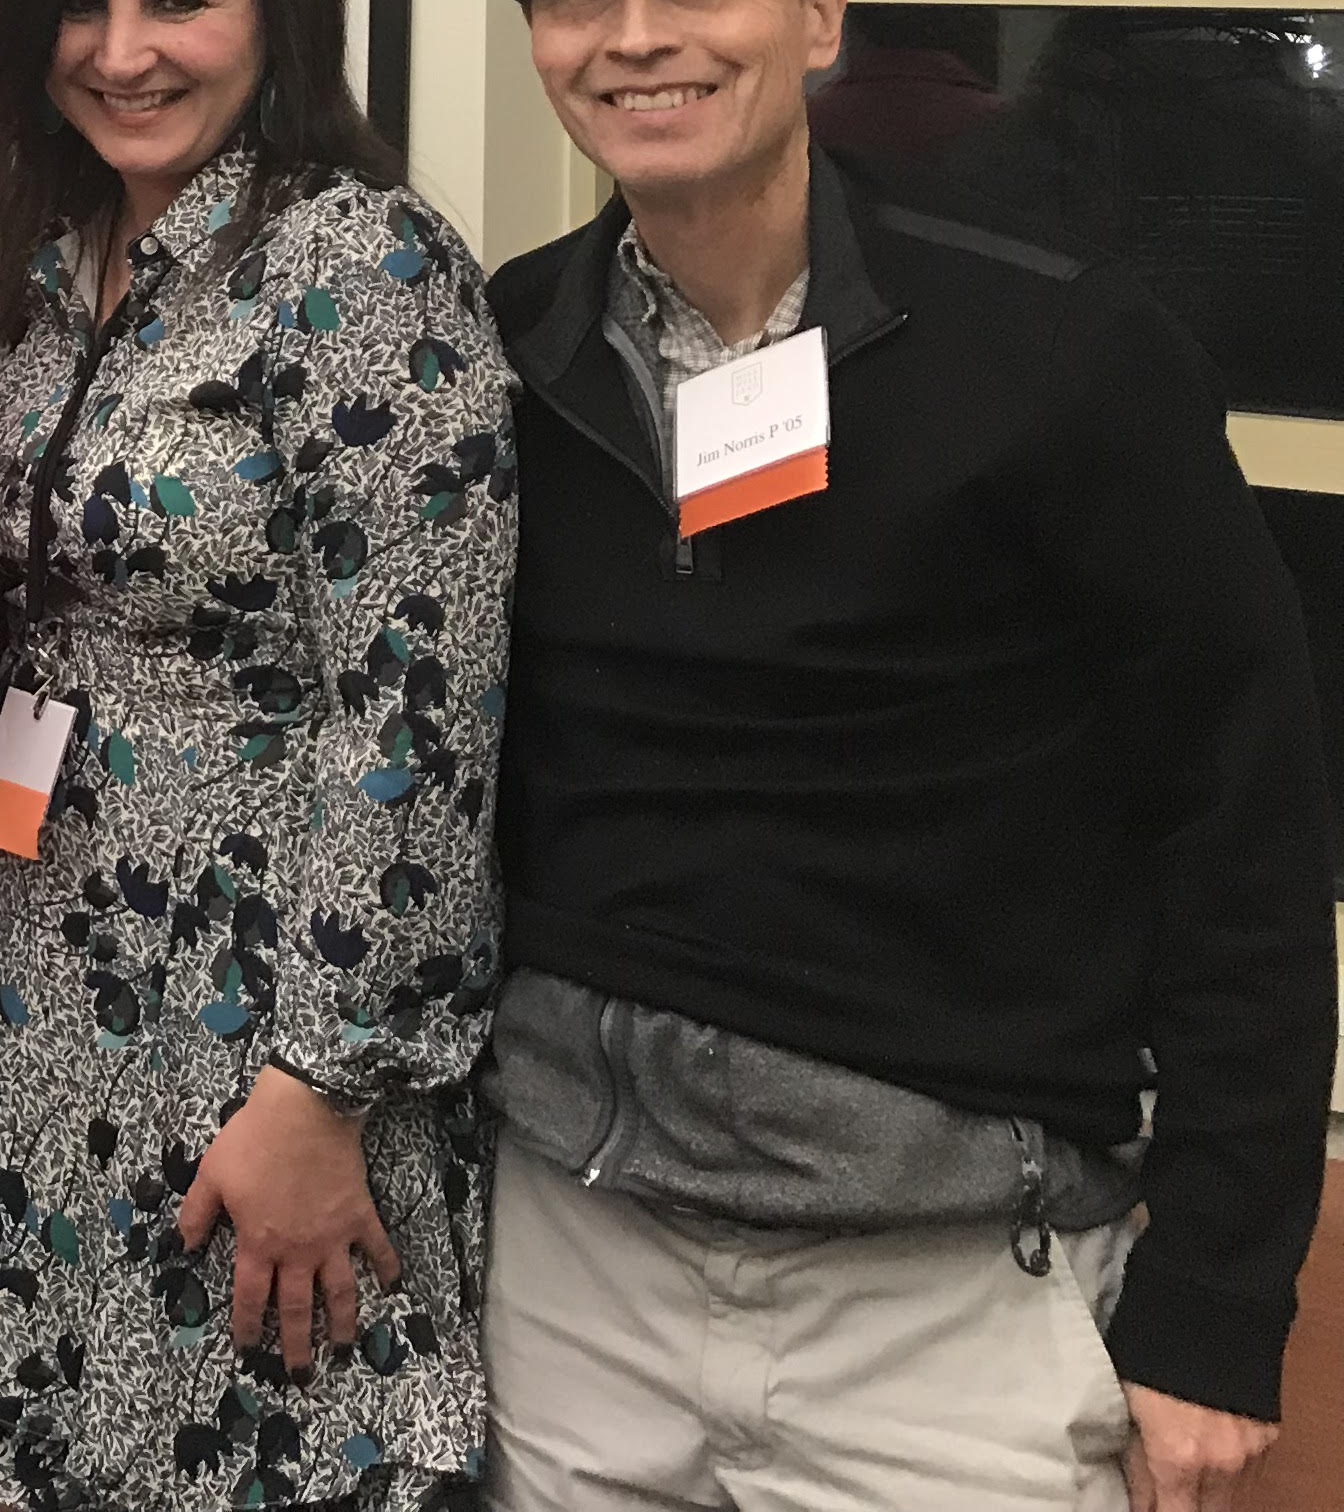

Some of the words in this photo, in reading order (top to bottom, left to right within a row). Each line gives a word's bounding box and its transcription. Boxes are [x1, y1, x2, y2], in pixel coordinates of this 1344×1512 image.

[696, 447, 720, 467] Jim
[723, 432, 765, 455] Norris
[768, 423, 779, 439] P
[782, 415, 804, 433] '05
